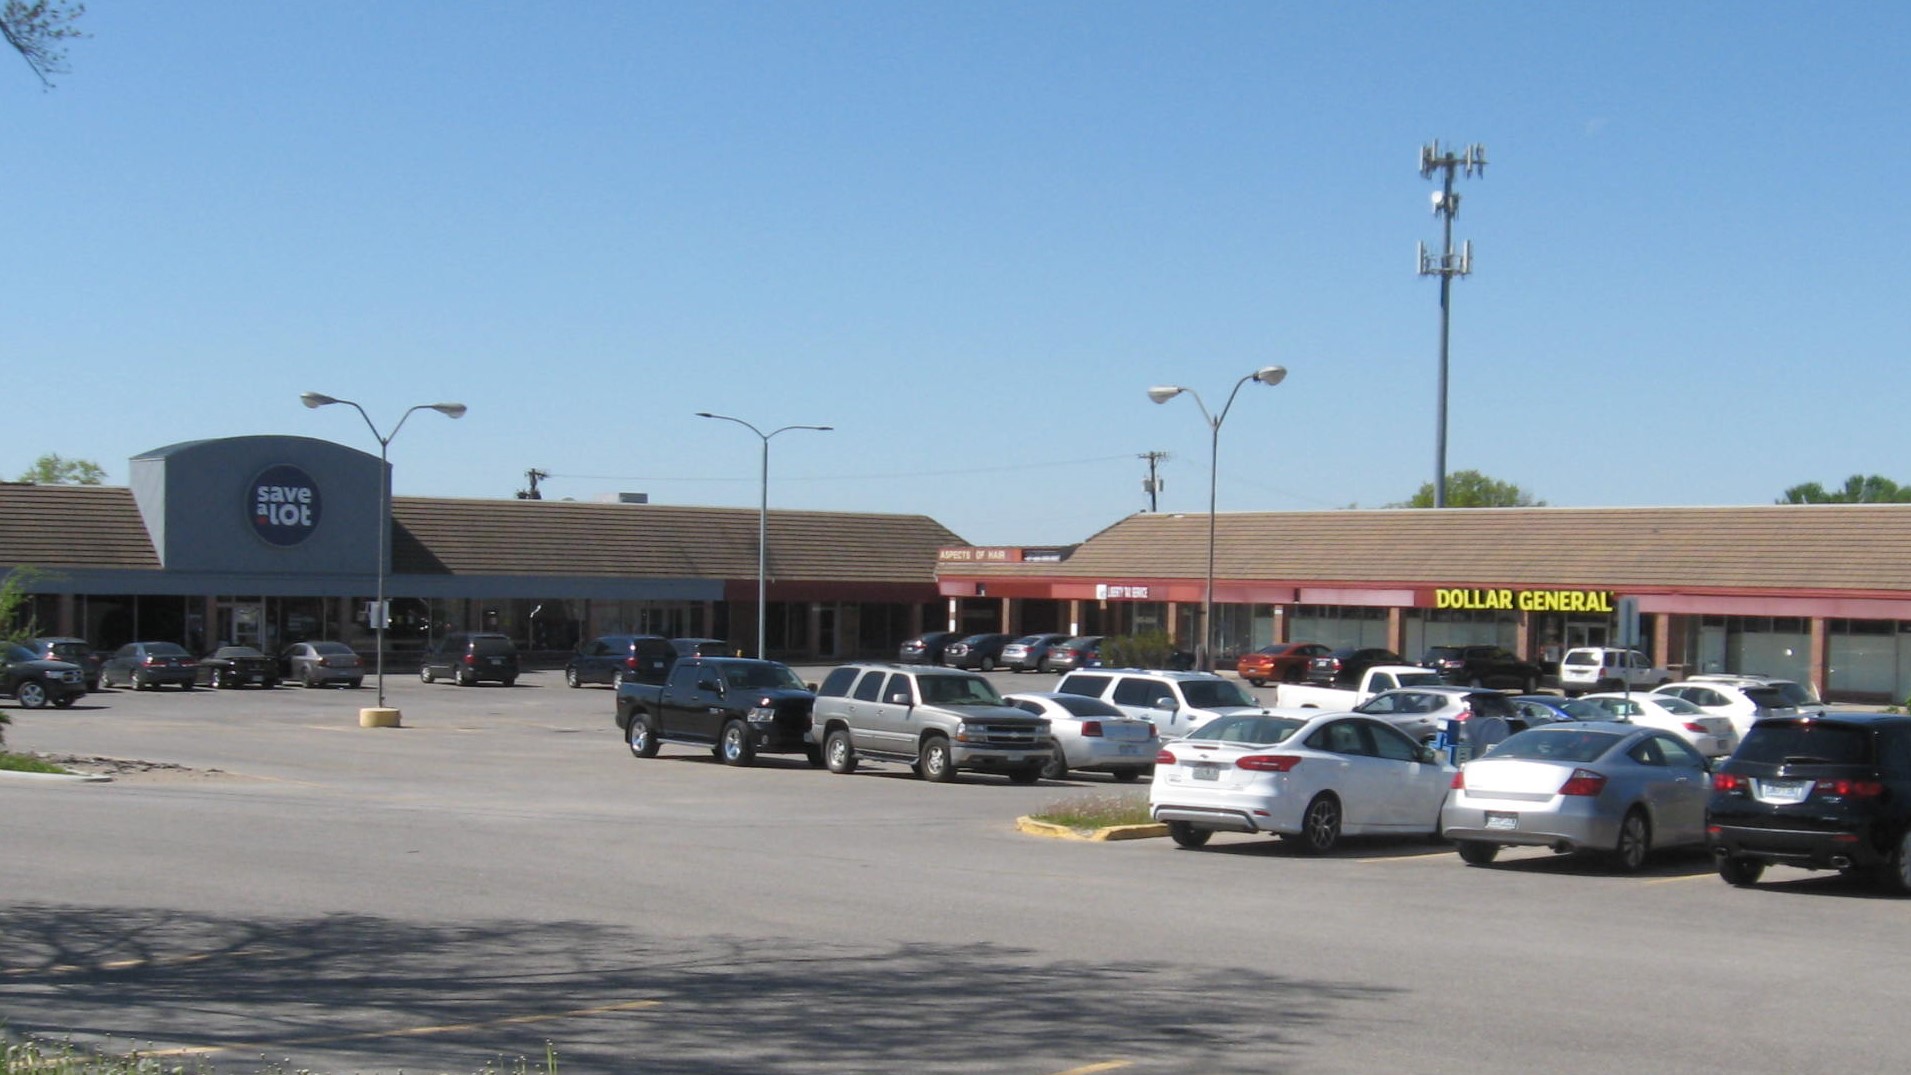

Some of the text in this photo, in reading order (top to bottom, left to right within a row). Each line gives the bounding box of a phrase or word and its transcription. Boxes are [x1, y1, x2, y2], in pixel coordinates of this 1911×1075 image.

[257, 485, 311, 503] save
[257, 503, 311, 526] a lot
[940, 550, 970, 560] ASPECTS
[975, 550, 985, 560] OF
[1436, 589, 1613, 611] DOLLAR GENERAL
